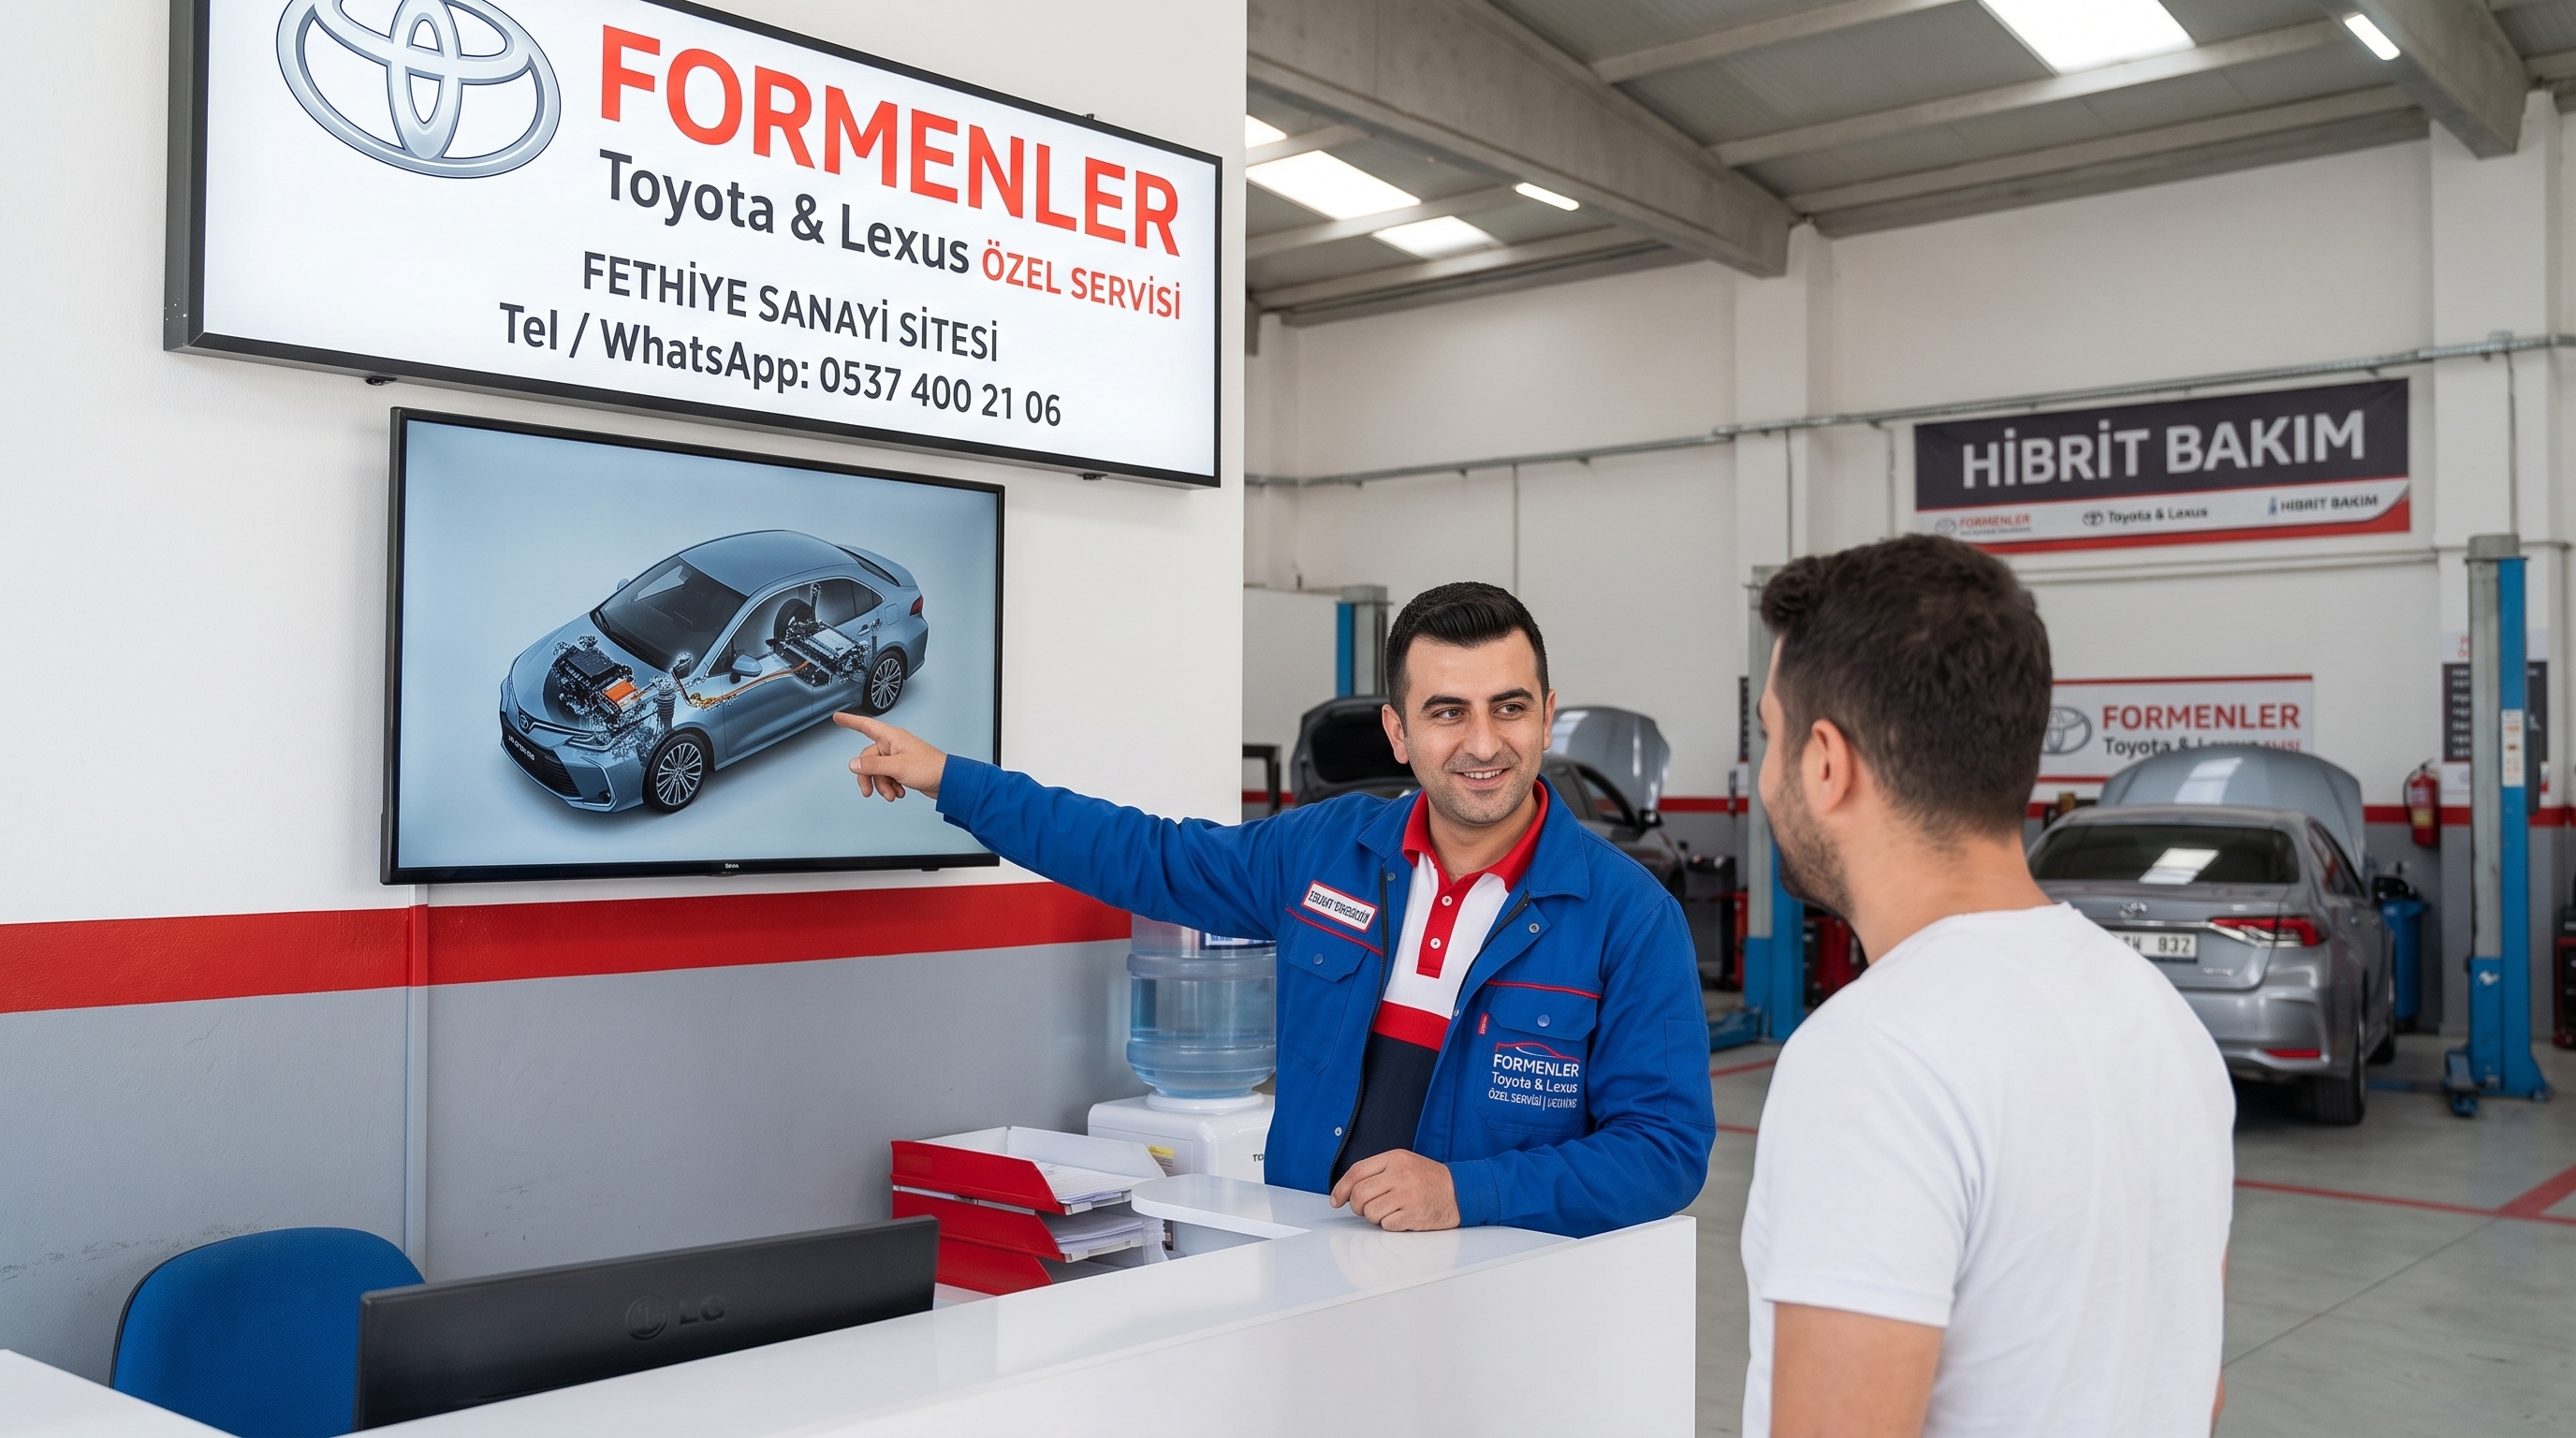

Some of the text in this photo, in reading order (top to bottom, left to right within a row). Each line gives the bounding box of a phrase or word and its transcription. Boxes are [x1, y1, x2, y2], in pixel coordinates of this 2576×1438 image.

[601, 23, 1180, 257] FORMENLER
[599, 148, 1181, 320] Toyota & Lexus ÖZEL SERVİSİ
[583, 250, 999, 362] FETHİYE SANAYİ SİTESİ
[499, 301, 1061, 427] Tel / WhatsApp: 0537 400 21 06
[1963, 409, 2364, 489] HİBRİT BAKIM
[2108, 510, 2151, 525] Toyota
[2168, 506, 2207, 520] Lexus
[2102, 703, 2301, 731] FORMENLER
[2103, 736, 2171, 759] Toyota
[1493, 1053, 1579, 1078] FORMENLER
[1491, 1071, 1578, 1093] Toyota & Lexus
[679, 1296, 724, 1326] LG
